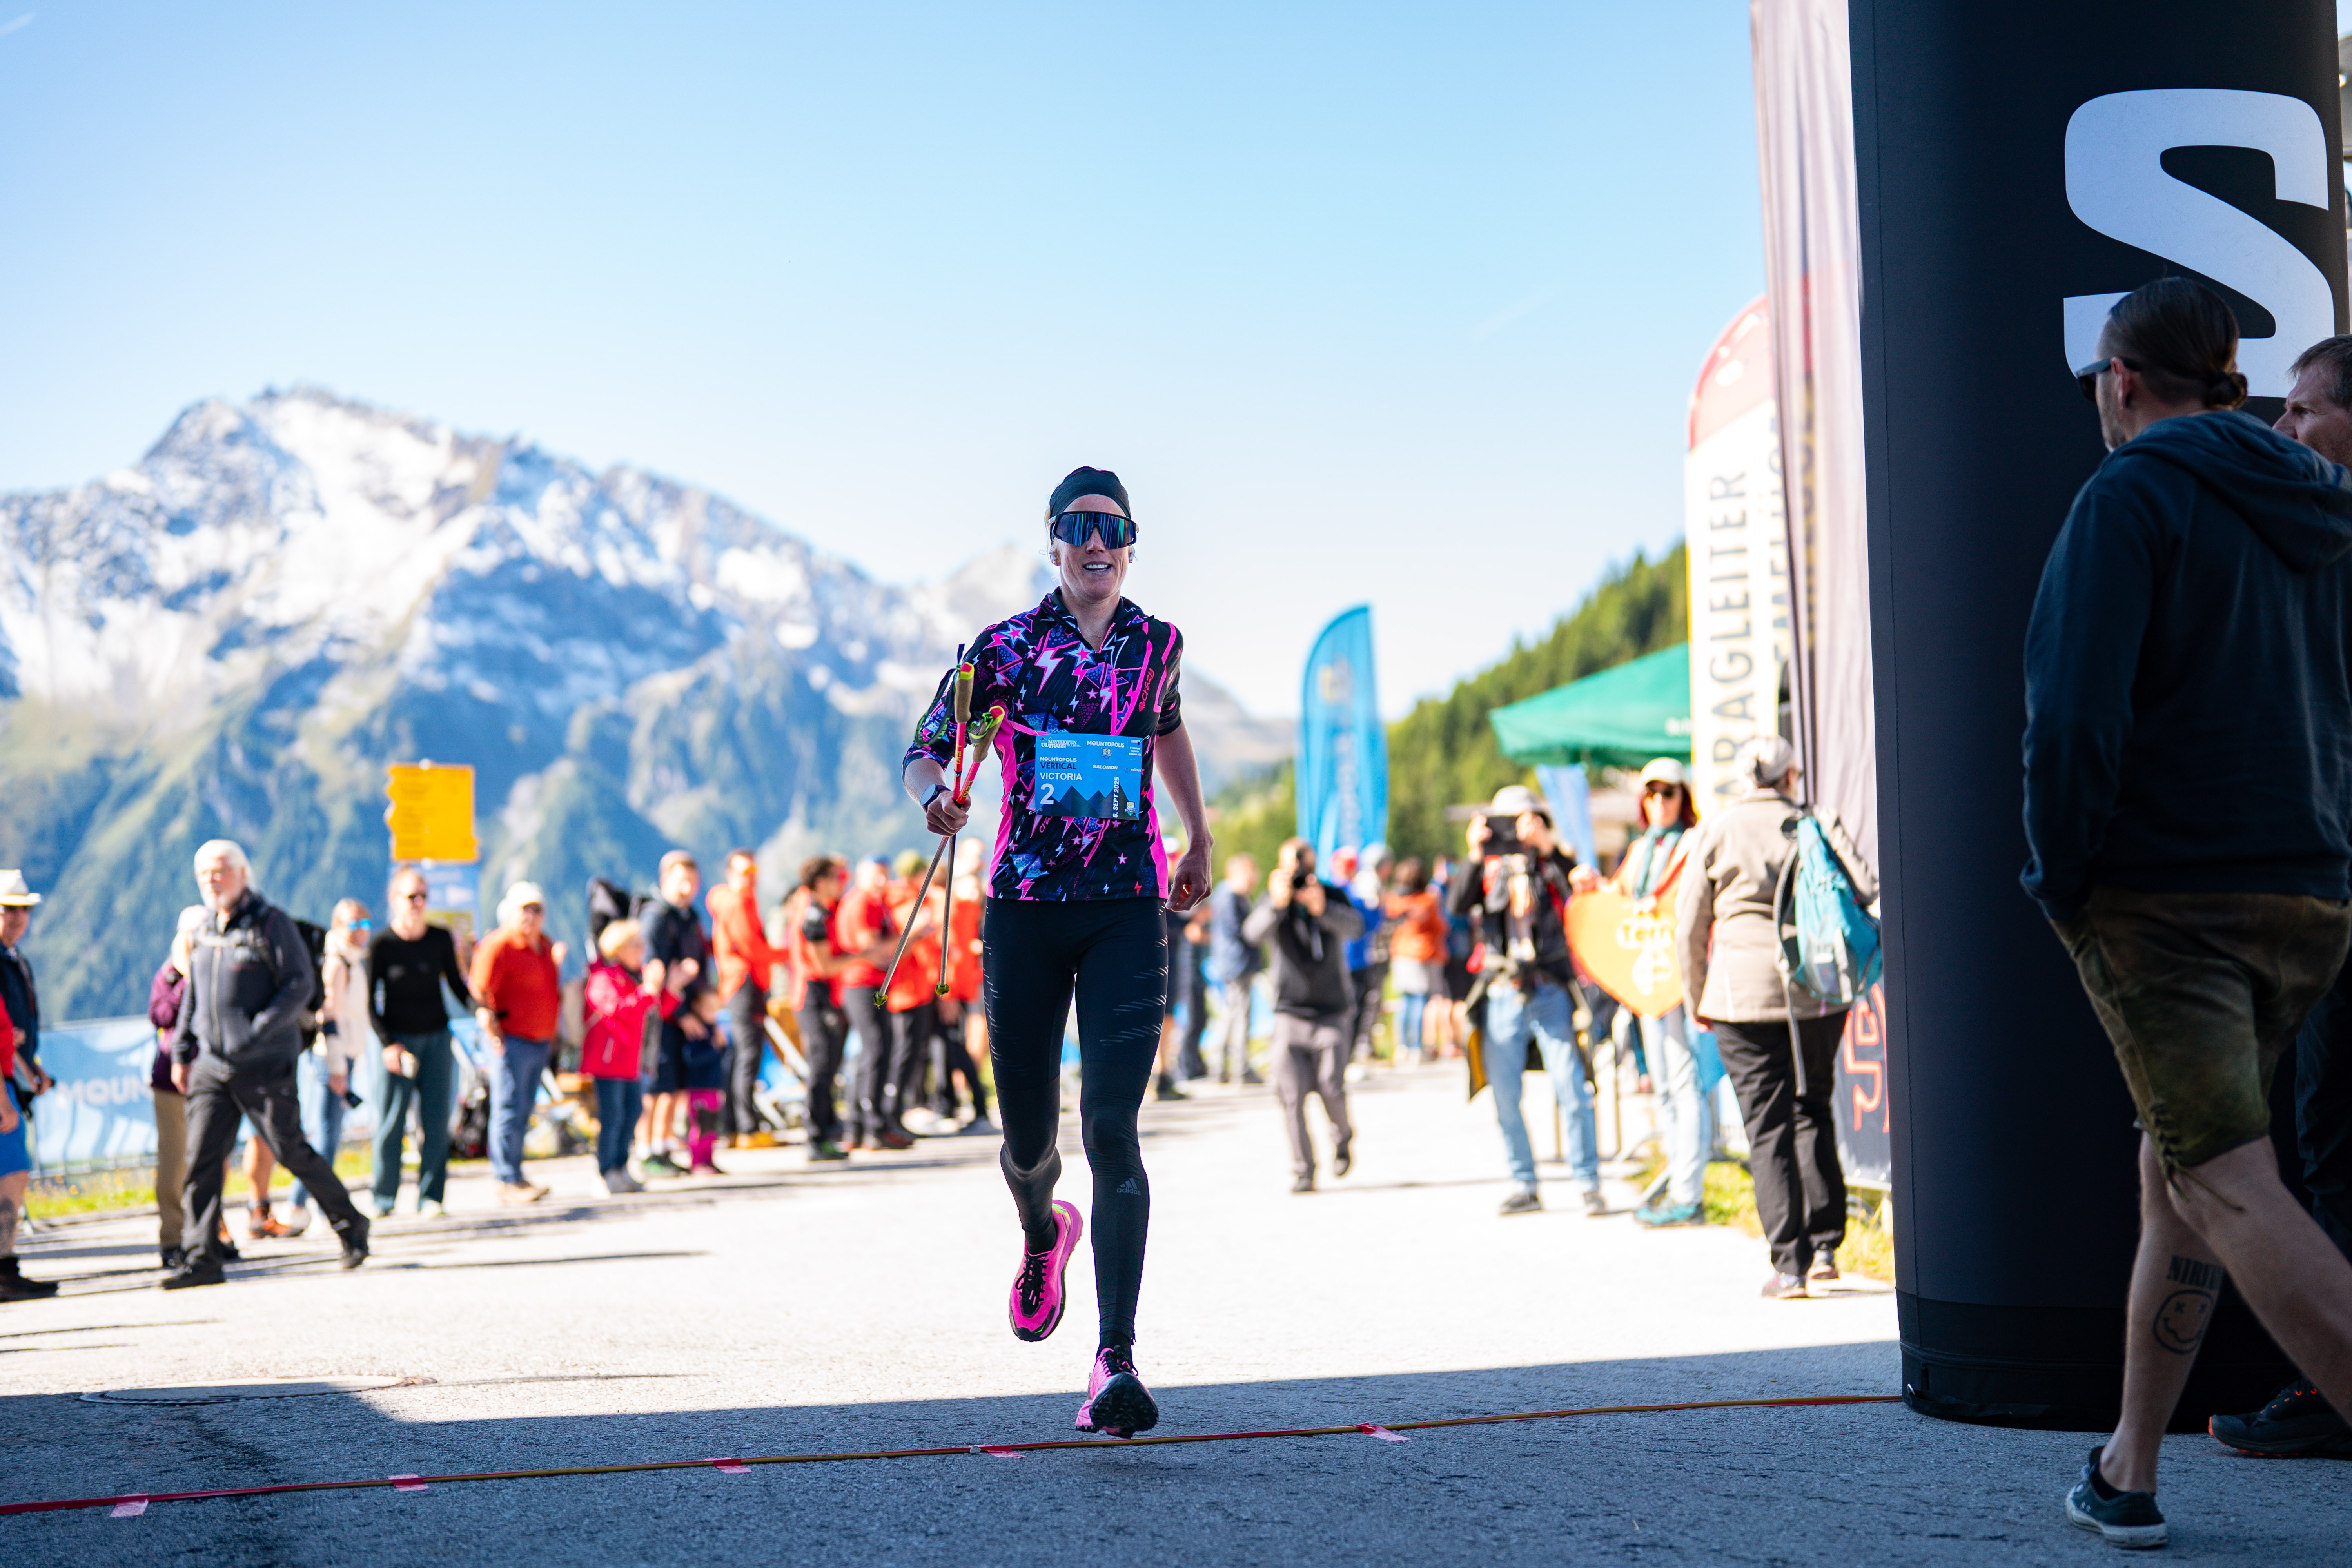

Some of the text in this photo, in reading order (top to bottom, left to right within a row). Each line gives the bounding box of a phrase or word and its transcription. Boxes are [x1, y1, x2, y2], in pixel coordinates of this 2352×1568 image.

[2063, 89, 2335, 397] S
[1710, 471, 1752, 797] ARAGLEITER
[1142, 668, 1154, 701] crazy
[1040, 772, 1082, 780] VICTORIA
[1040, 783, 1054, 804] 2
[1116, 1187, 1141, 1195] adidas
